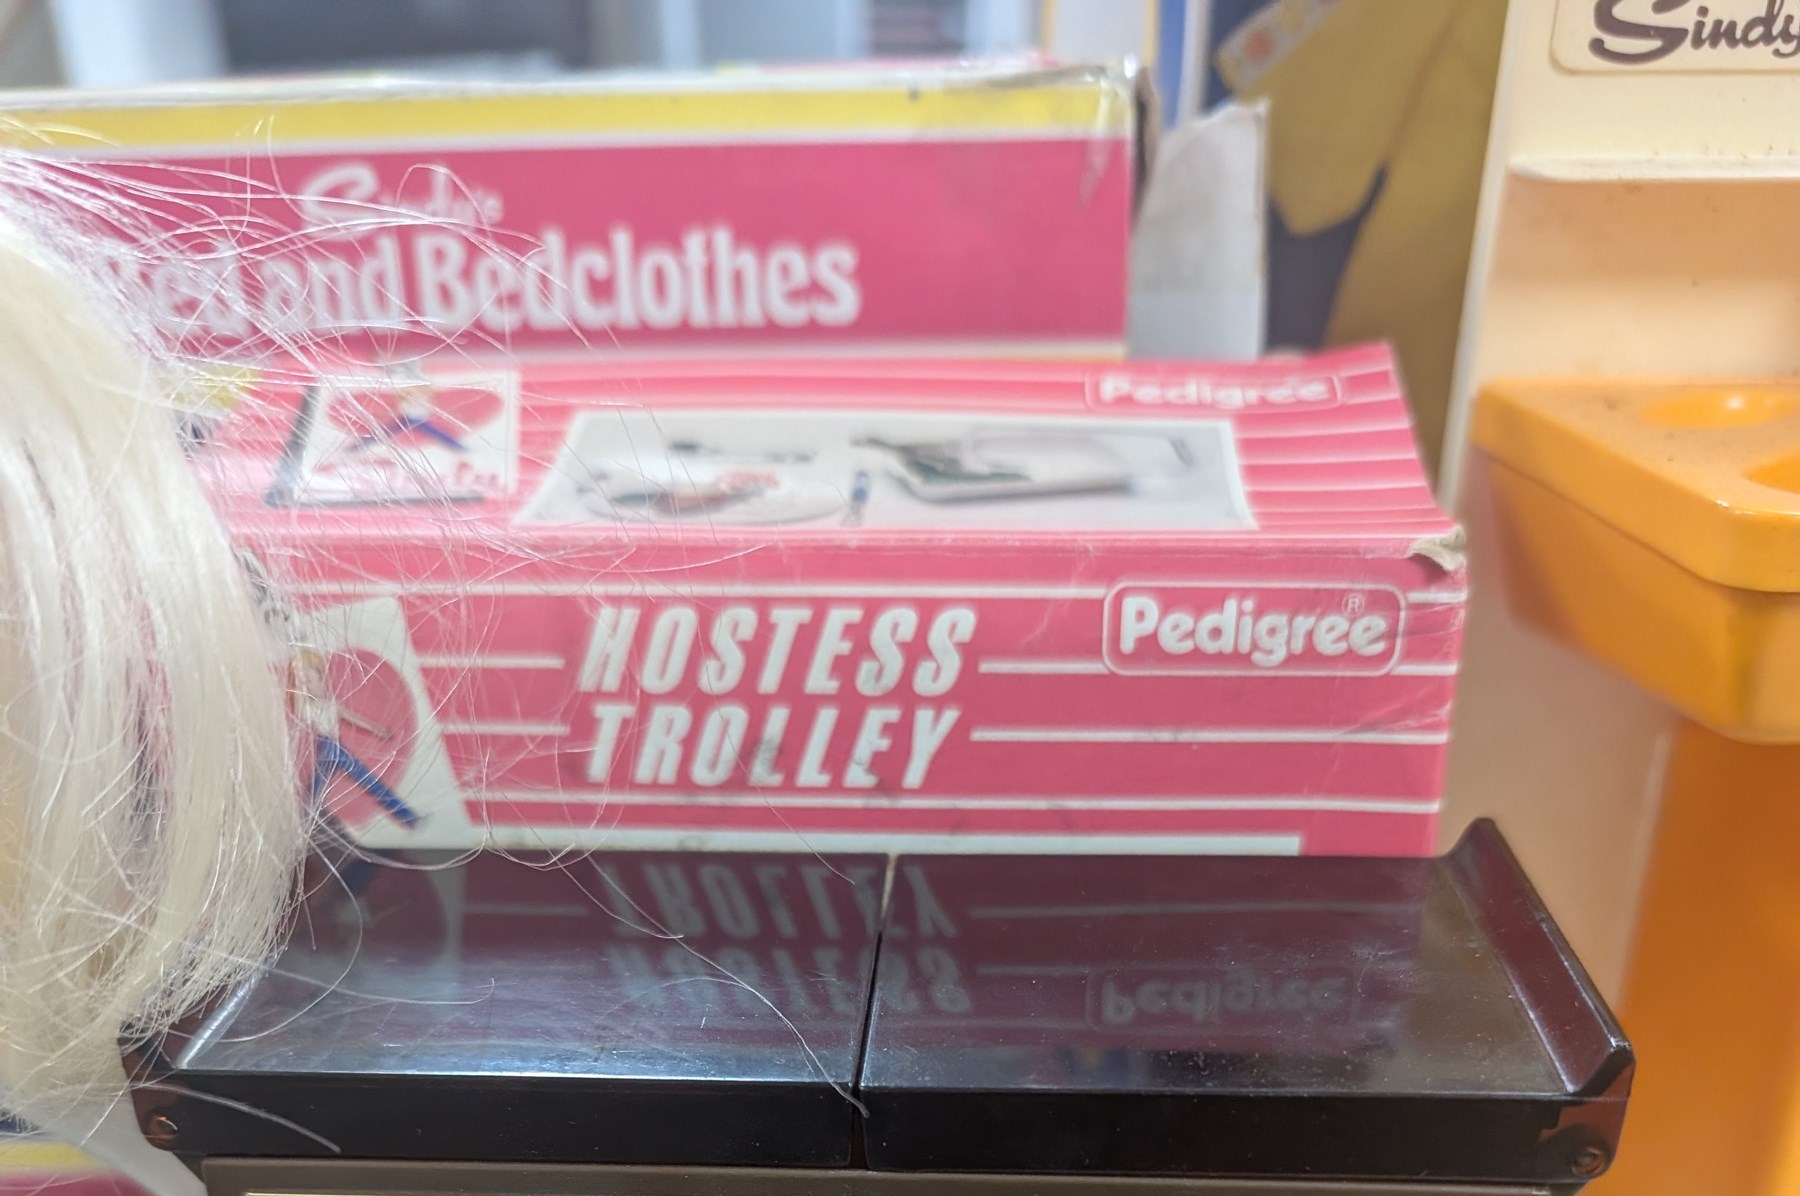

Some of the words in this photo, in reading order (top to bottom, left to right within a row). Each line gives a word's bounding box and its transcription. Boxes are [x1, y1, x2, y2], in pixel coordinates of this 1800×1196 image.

[1588, 0, 1800, 66] Sindy
[258, 234, 400, 335] and
[414, 225, 862, 330] Bedclothes
[1101, 370, 1329, 409] Pedigree
[577, 605, 978, 698] HOSTESS
[1119, 595, 1387, 668] Pedigree
[586, 703, 961, 790] TROLLEY
